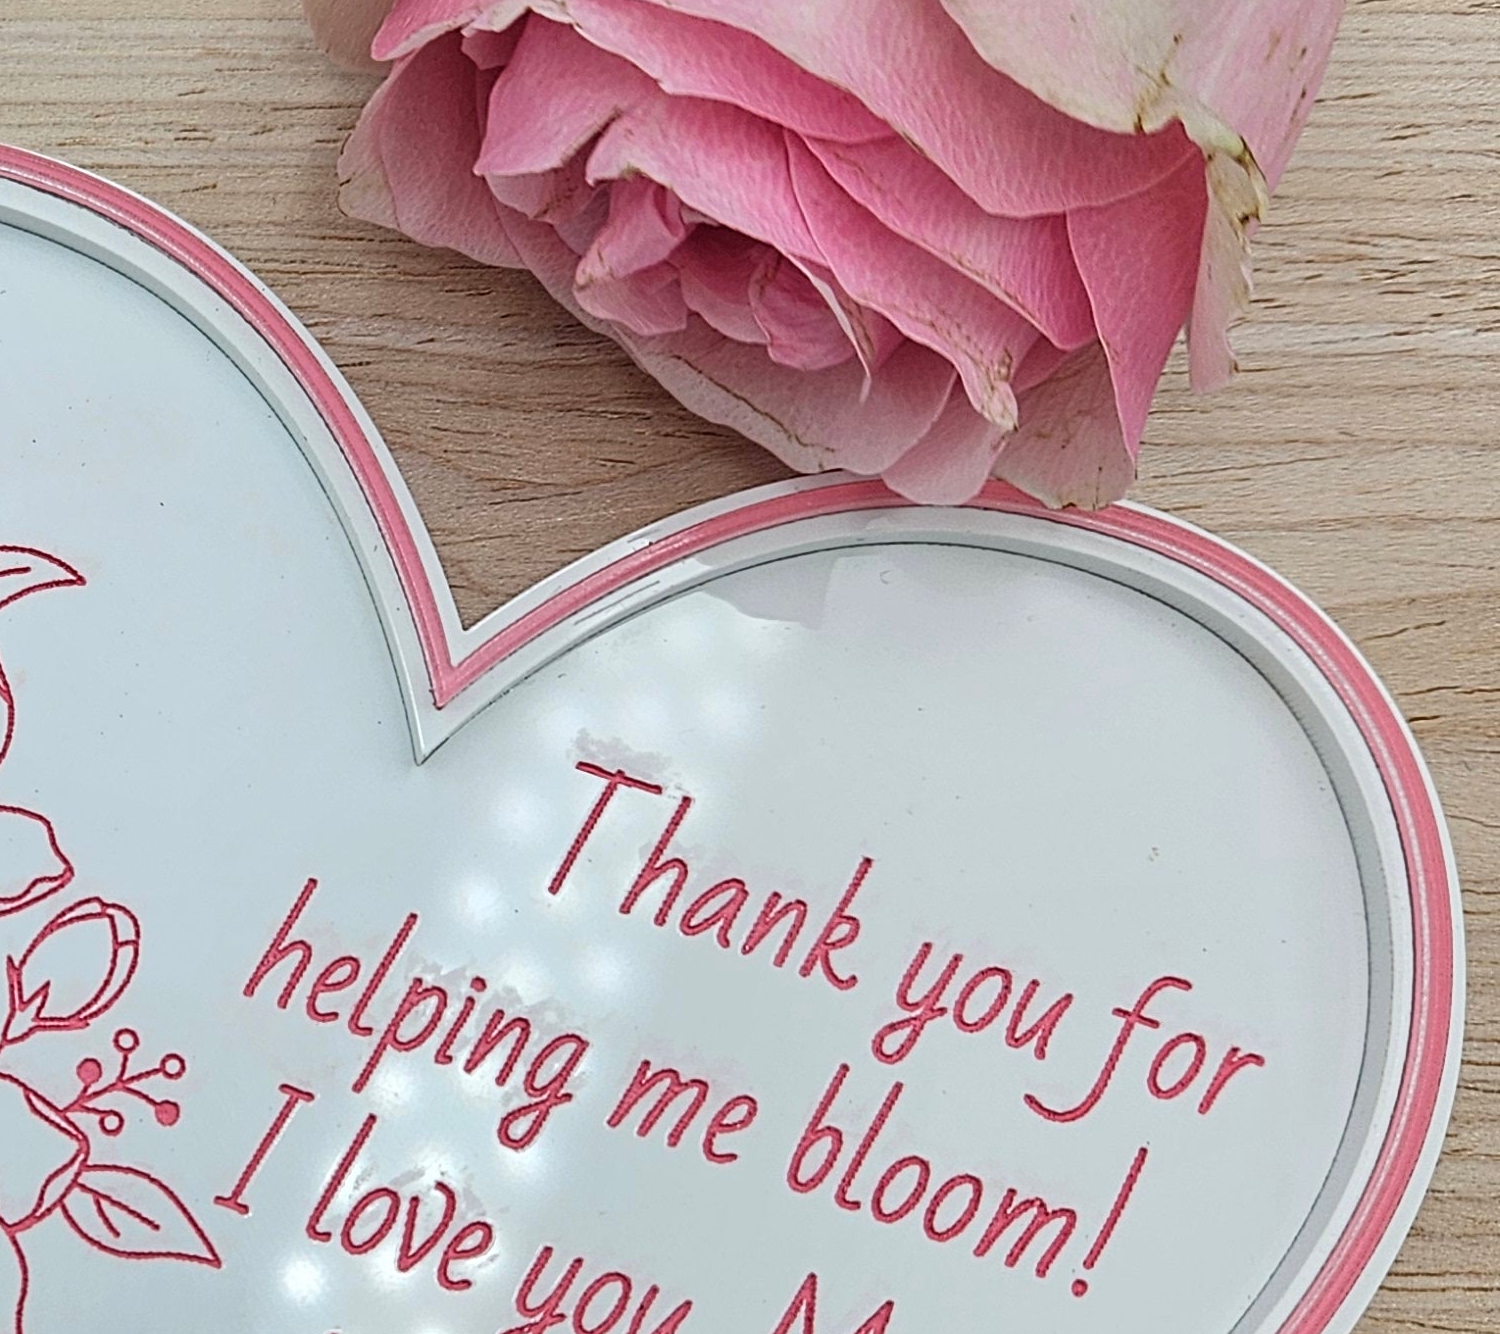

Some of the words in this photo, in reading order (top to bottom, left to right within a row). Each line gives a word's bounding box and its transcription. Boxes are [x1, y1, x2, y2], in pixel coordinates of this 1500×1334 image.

[243, 878, 590, 1151] helping
[607, 1059, 758, 1164] me
[787, 1063, 1149, 1297] bloom!
[548, 761, 873, 991] Thank
[872, 942, 1073, 1065] you
[1024, 976, 1265, 1124] for
[214, 1083, 315, 1216] I
[306, 1114, 494, 1291] love
